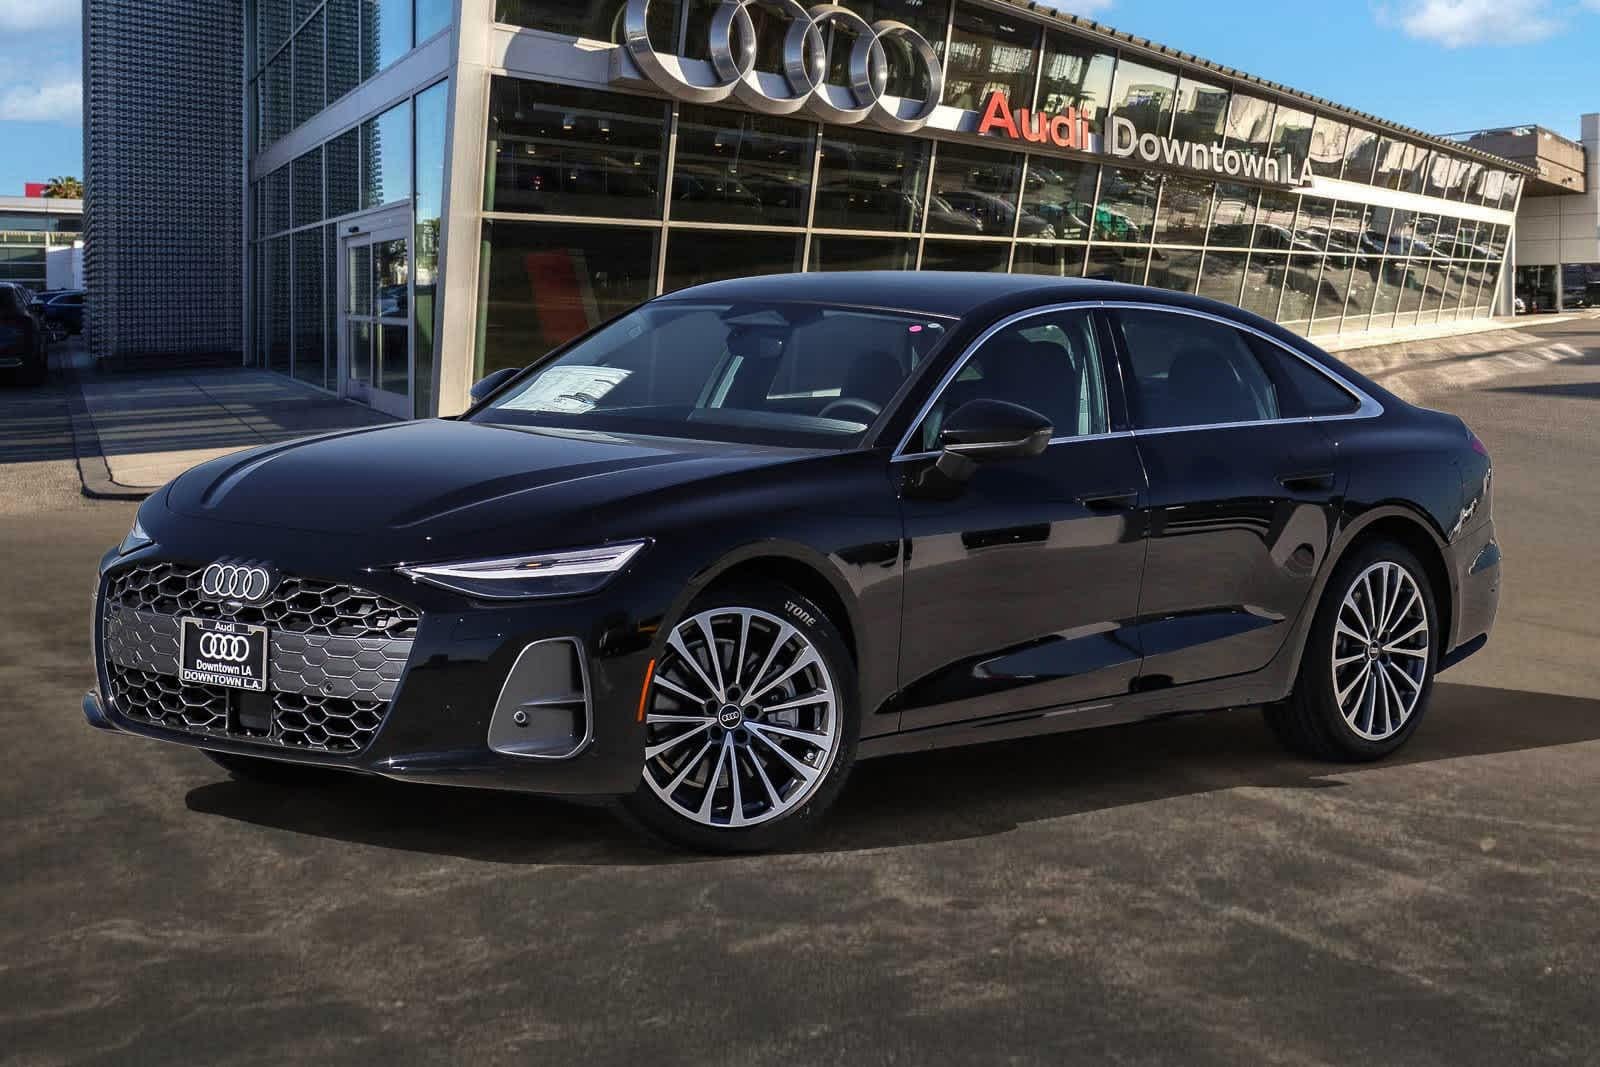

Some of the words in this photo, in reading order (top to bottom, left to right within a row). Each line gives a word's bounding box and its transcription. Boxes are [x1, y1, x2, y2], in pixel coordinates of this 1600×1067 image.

[978, 90, 1089, 149] Audi
[1108, 116, 1279, 181] Downtown
[1287, 153, 1316, 187] LA
[215, 622, 235, 633] Audi
[196, 659, 240, 675] Downtown
[241, 665, 253, 676] LA
[184, 671, 242, 687] DOWNTOWN
[243, 679, 262, 690] L.A.
